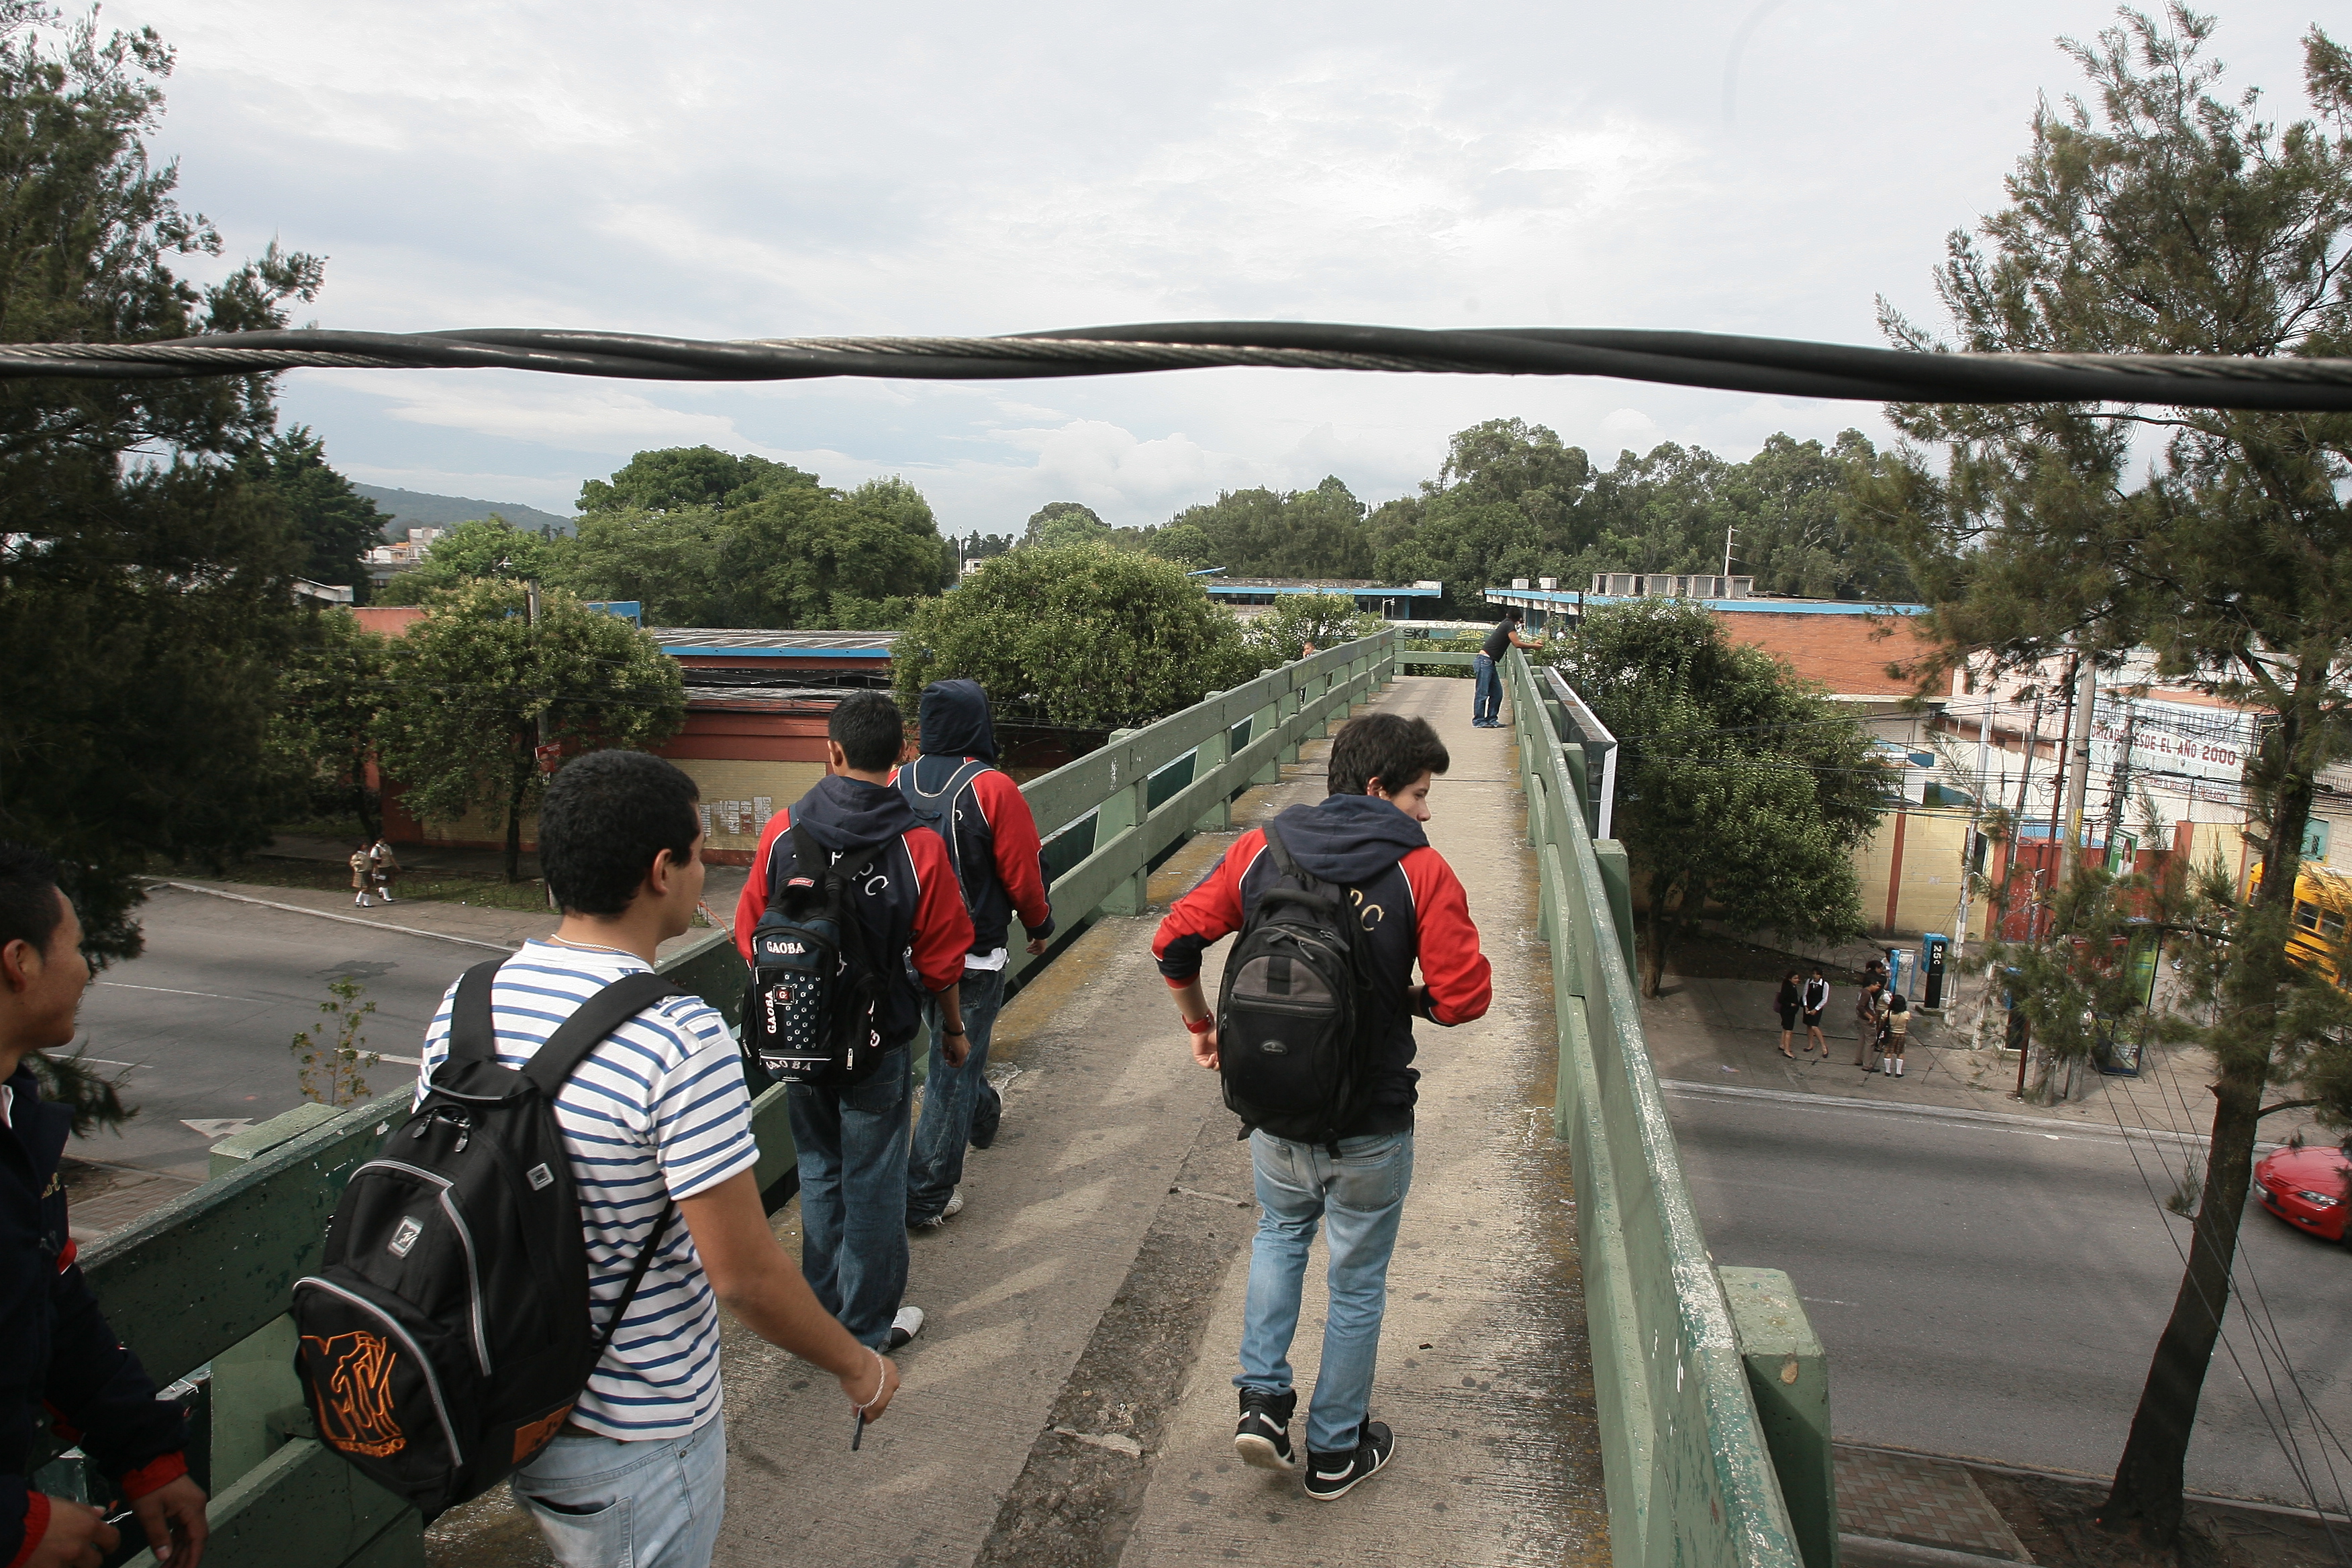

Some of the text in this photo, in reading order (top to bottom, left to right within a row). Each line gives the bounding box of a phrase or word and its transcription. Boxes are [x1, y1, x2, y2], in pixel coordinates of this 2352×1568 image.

[2133, 732, 2157, 750] ESDE
[2160, 737, 2171, 753] EL
[2177, 740, 2197, 758] AÑO
[2202, 746, 2236, 766] 2000
[767, 941, 805, 954] GAOBA
[765, 990, 777, 1034] GAOBA
